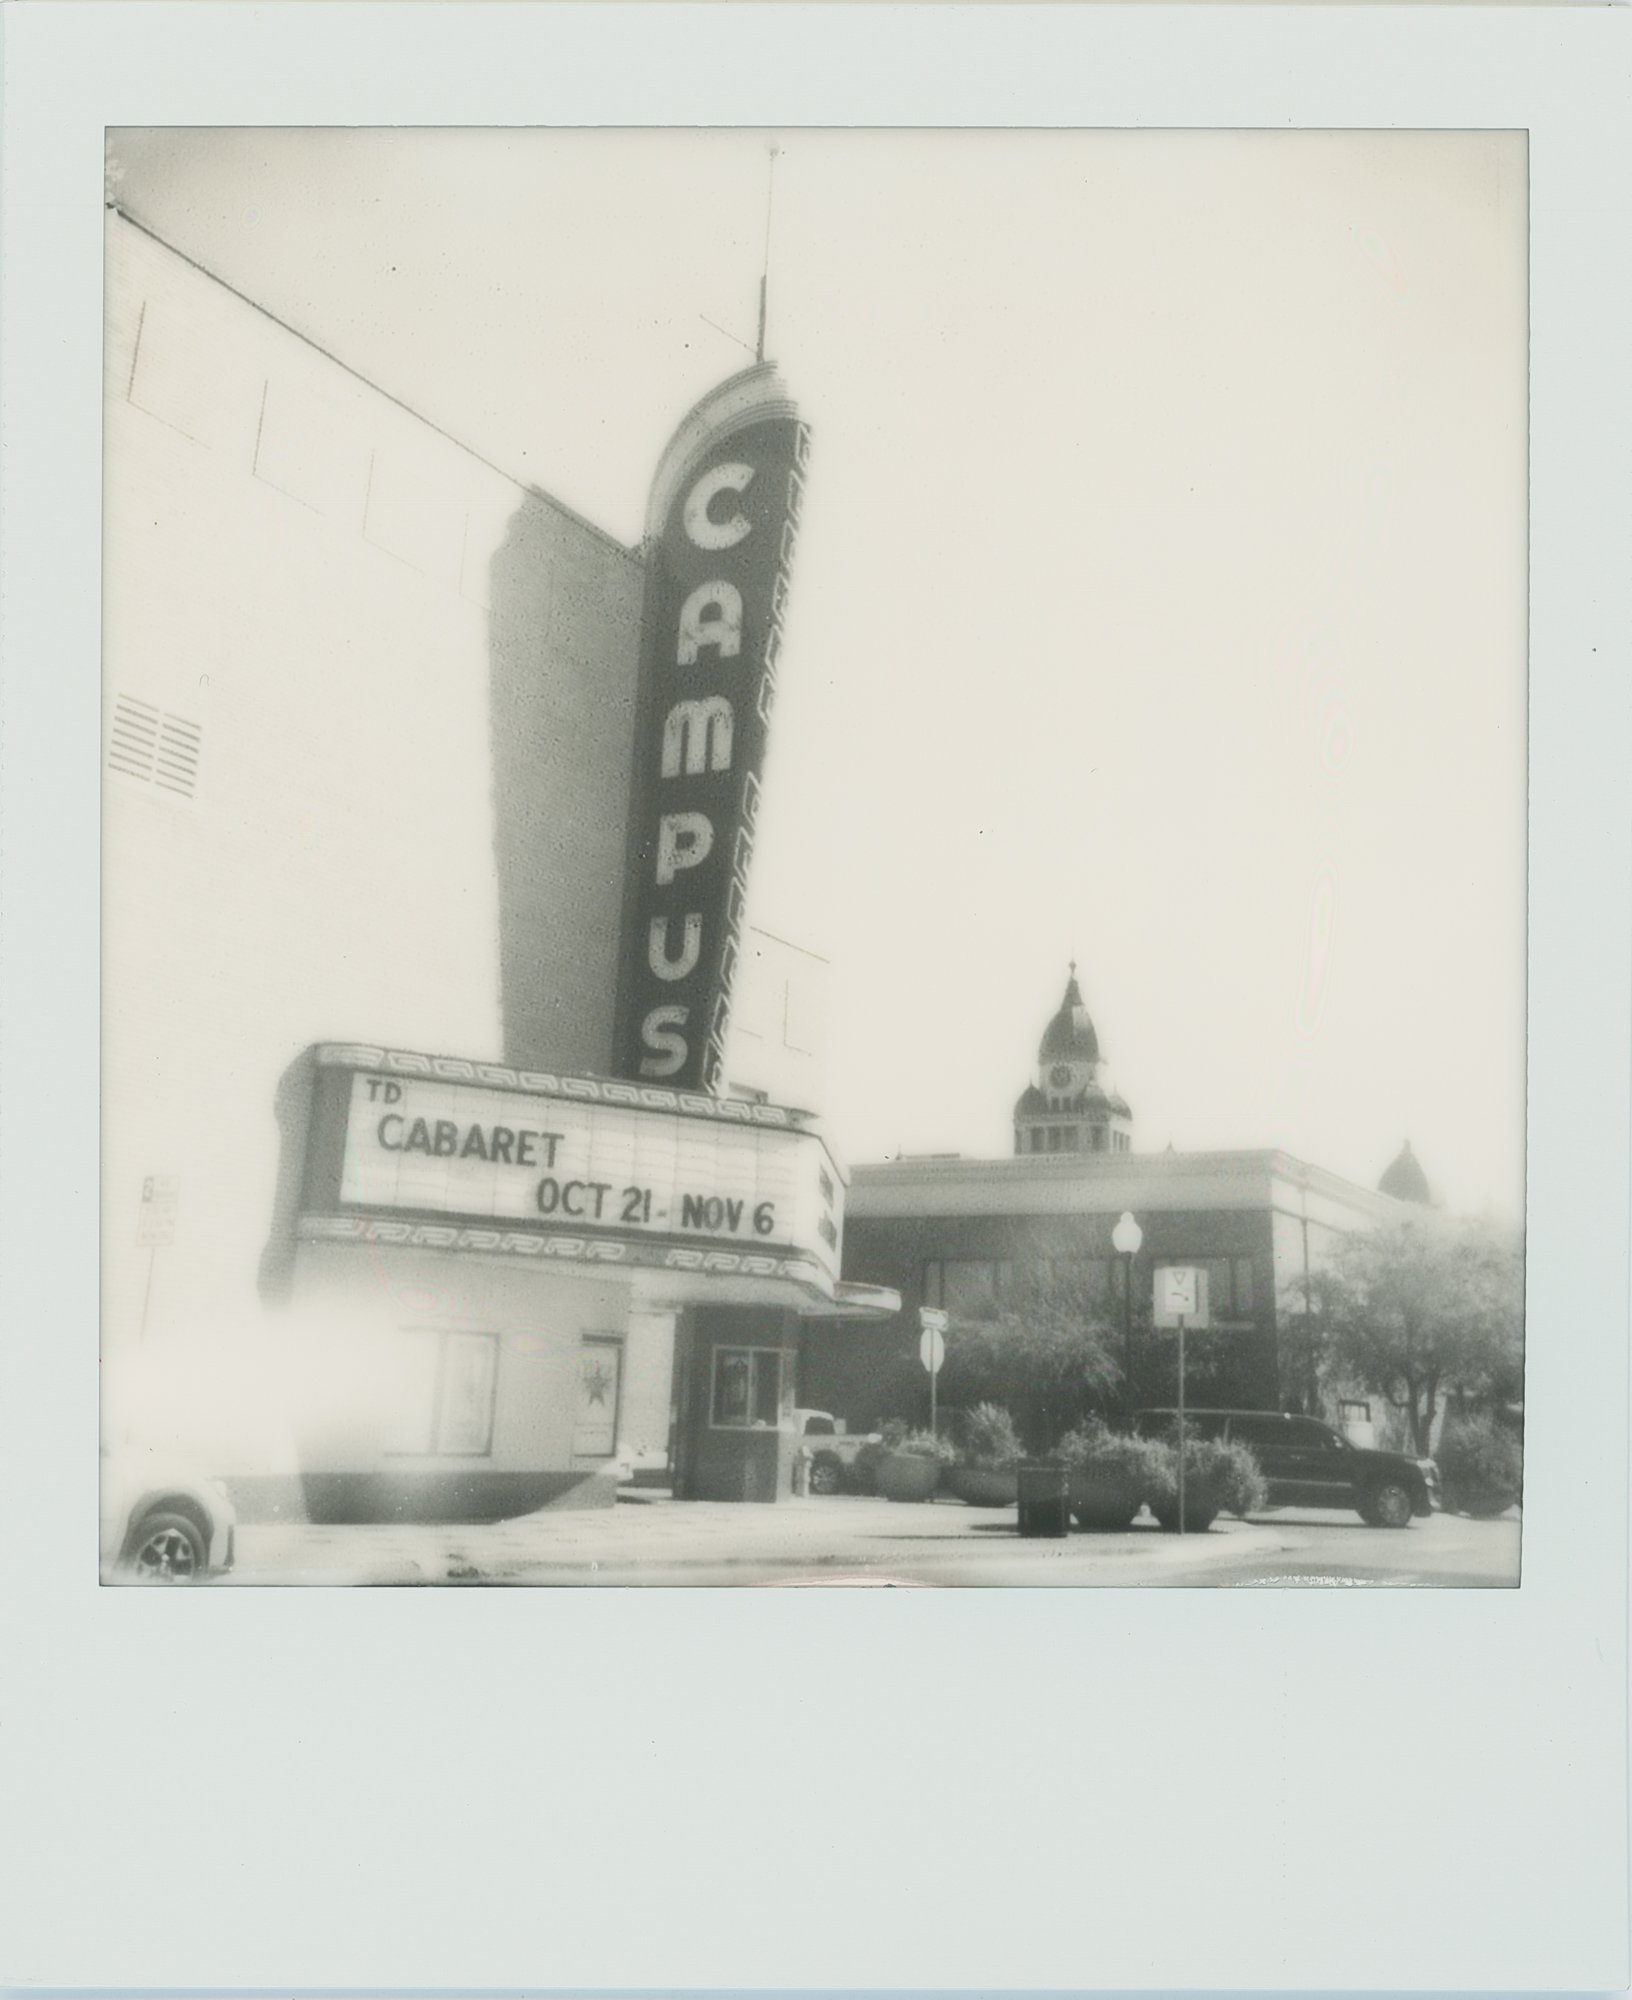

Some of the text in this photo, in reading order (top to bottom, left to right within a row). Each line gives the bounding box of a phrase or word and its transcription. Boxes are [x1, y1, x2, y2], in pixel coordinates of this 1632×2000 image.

[638, 461, 756, 1077] CAMPUS
[366, 1078, 403, 1105] TD
[376, 1112, 566, 1169] CABARET
[536, 1176, 613, 1219] OCT
[680, 1193, 744, 1233] NOV
[752, 1200, 776, 1236] 6
